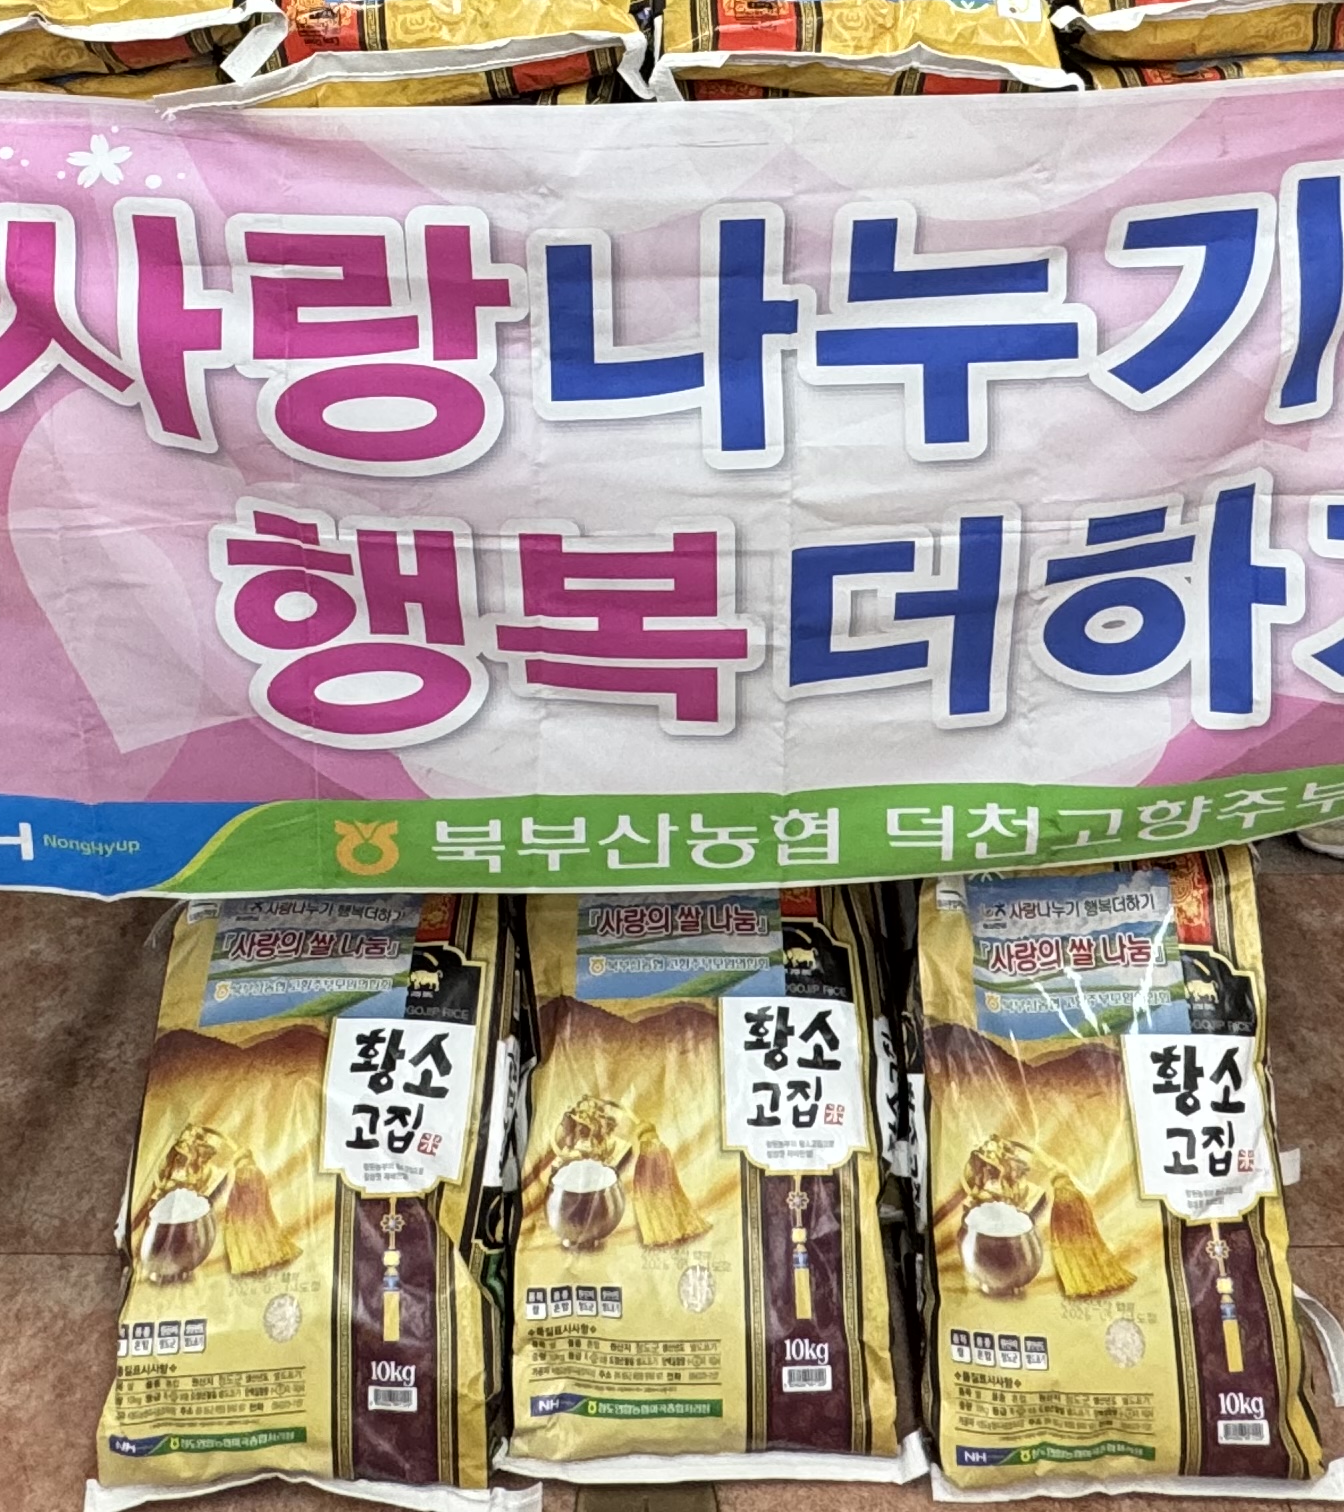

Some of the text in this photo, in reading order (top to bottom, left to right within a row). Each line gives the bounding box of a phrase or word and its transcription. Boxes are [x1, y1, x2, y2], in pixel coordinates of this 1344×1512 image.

[431, 806, 841, 874] 북부산농협
[676, 904, 703, 934] 쌀
[1009, 899, 1081, 920] 사랑나누기
[1084, 892, 1155, 917] 행복더하기
[308, 931, 336, 958] 쌀
[1067, 935, 1097, 968] 쌀
[743, 1005, 842, 1072] 황소
[349, 1027, 453, 1100] 황소
[1149, 1043, 1247, 1118] 황소
[746, 1075, 823, 1129] 고집
[345, 1102, 425, 1155] 고집
[1163, 1120, 1236, 1178] 고집
[783, 1338, 830, 1365] 10kg
[369, 1359, 417, 1387] 10kg
[538, 1399, 561, 1413] NH
[1217, 1391, 1265, 1419] 10kg
[963, 1450, 988, 1464] NH
